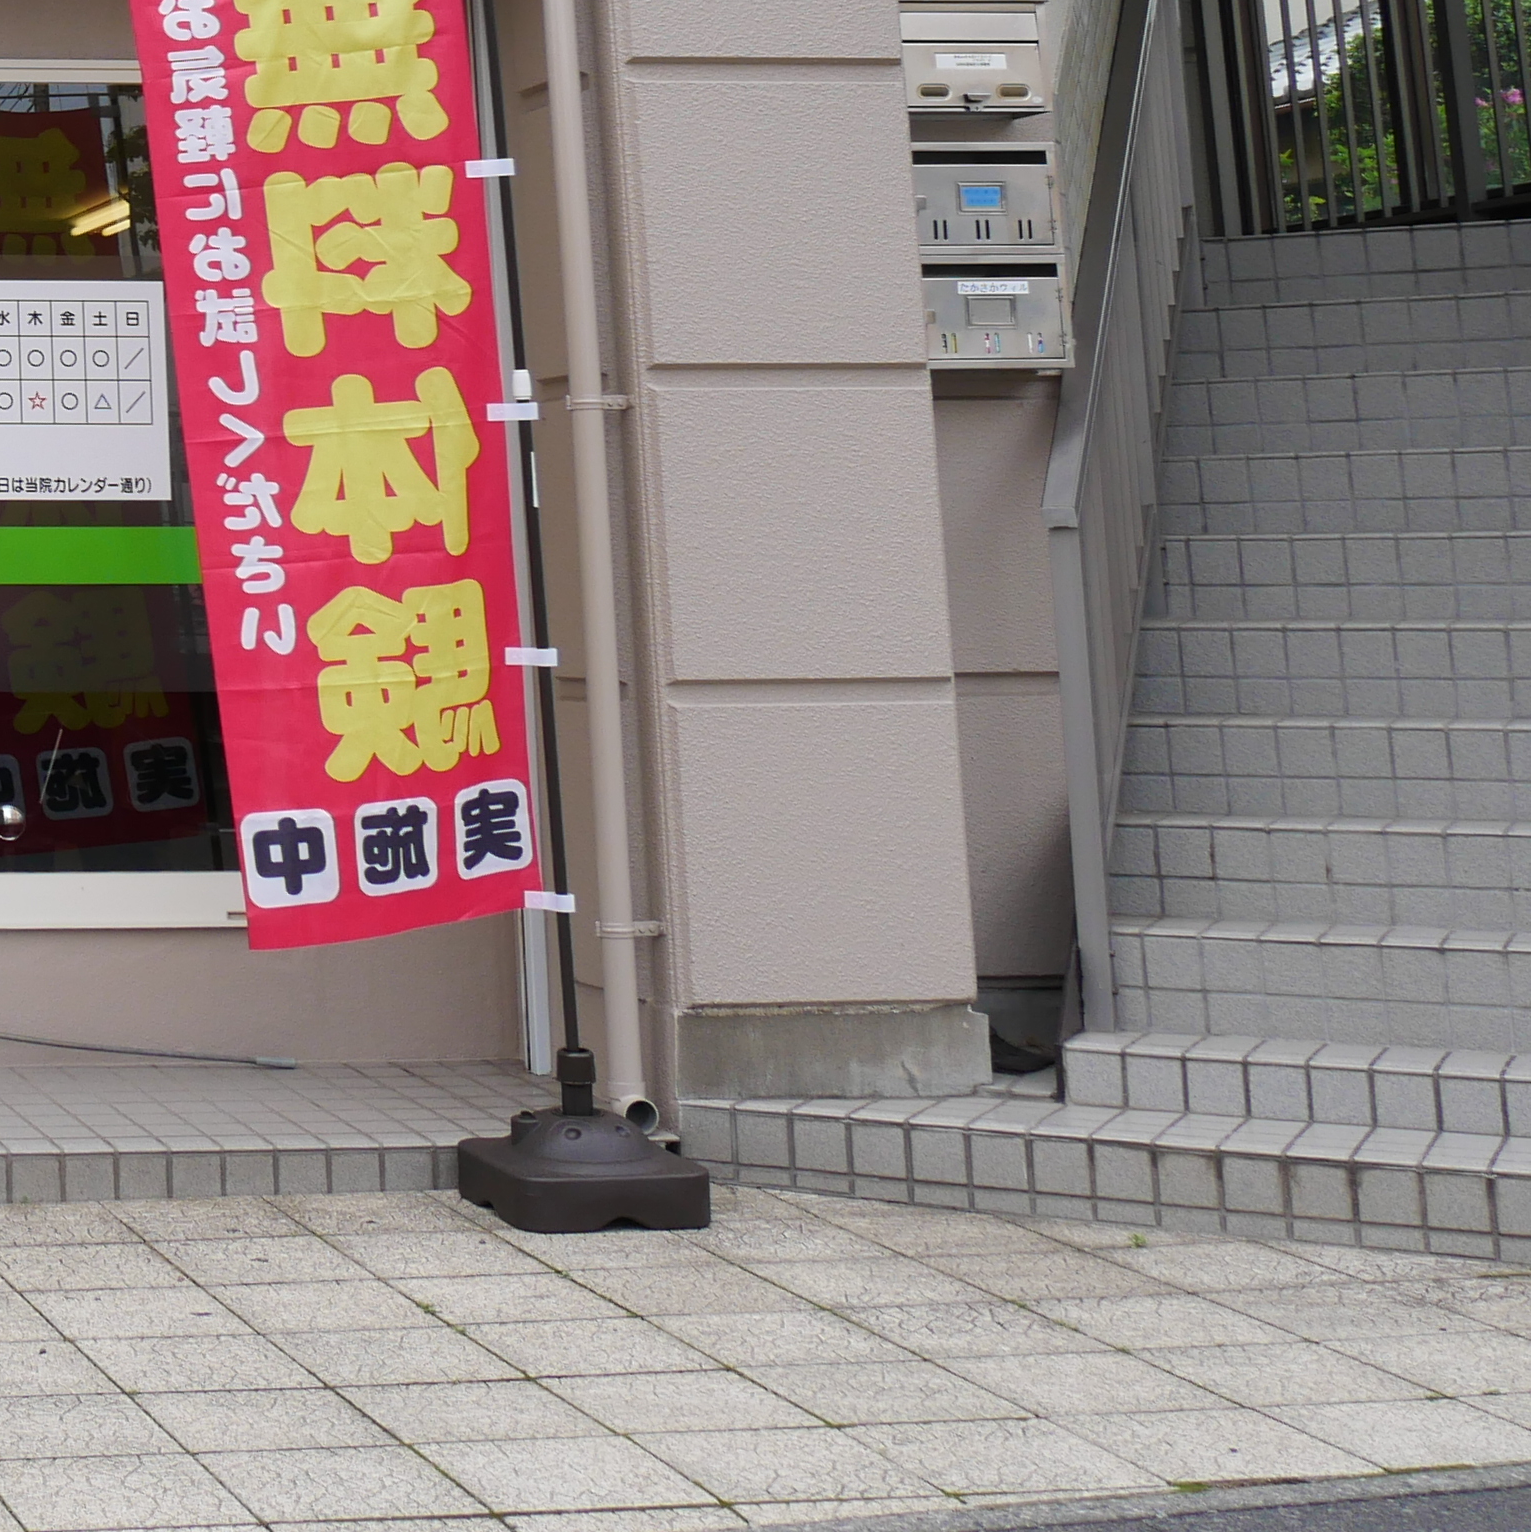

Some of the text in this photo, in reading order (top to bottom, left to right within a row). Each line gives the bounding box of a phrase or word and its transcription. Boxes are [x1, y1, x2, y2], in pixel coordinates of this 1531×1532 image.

[27, 310, 44, 327] 木
[59, 310, 77, 327] 金
[92, 310, 110, 327] 土
[126, 310, 140, 327] 日
